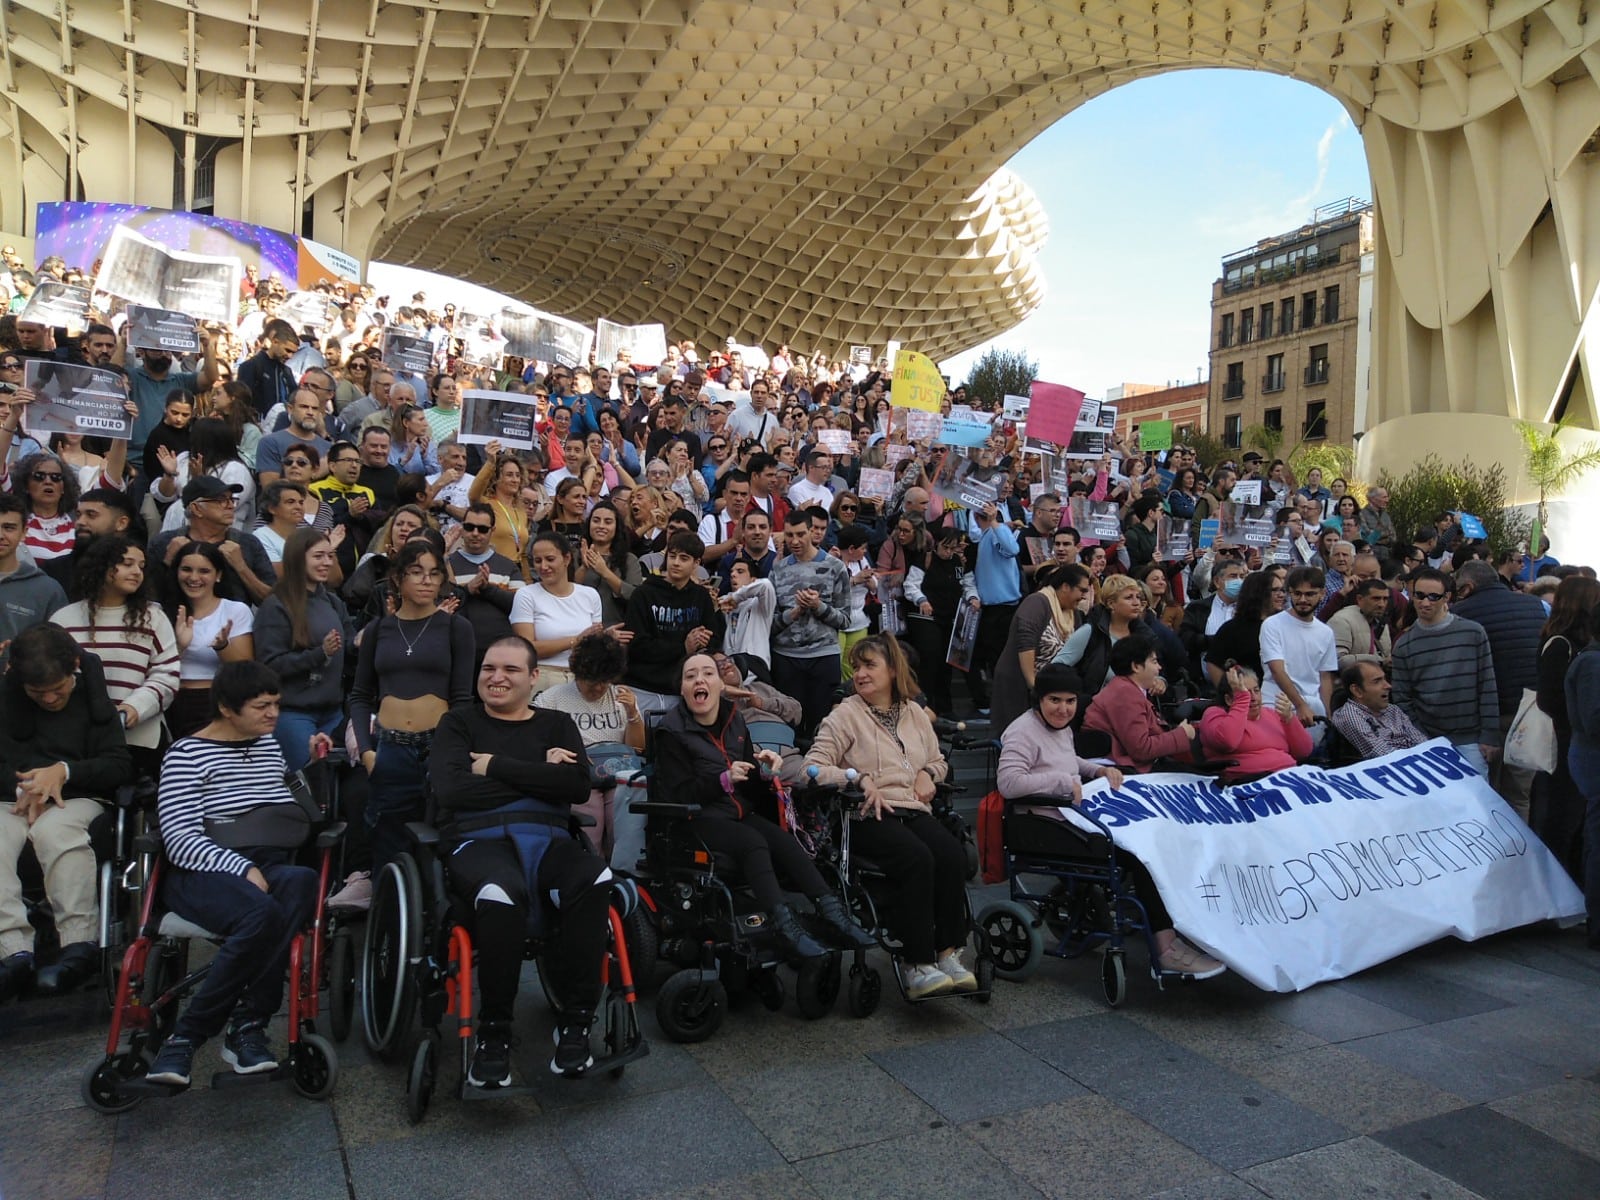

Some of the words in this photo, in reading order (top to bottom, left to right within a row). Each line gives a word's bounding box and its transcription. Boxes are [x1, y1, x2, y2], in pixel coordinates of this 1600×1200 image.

[163, 338, 193, 347] FUTURO
[80, 417, 122, 429] FUTURO
[1363, 743, 1481, 796] FUTUR
